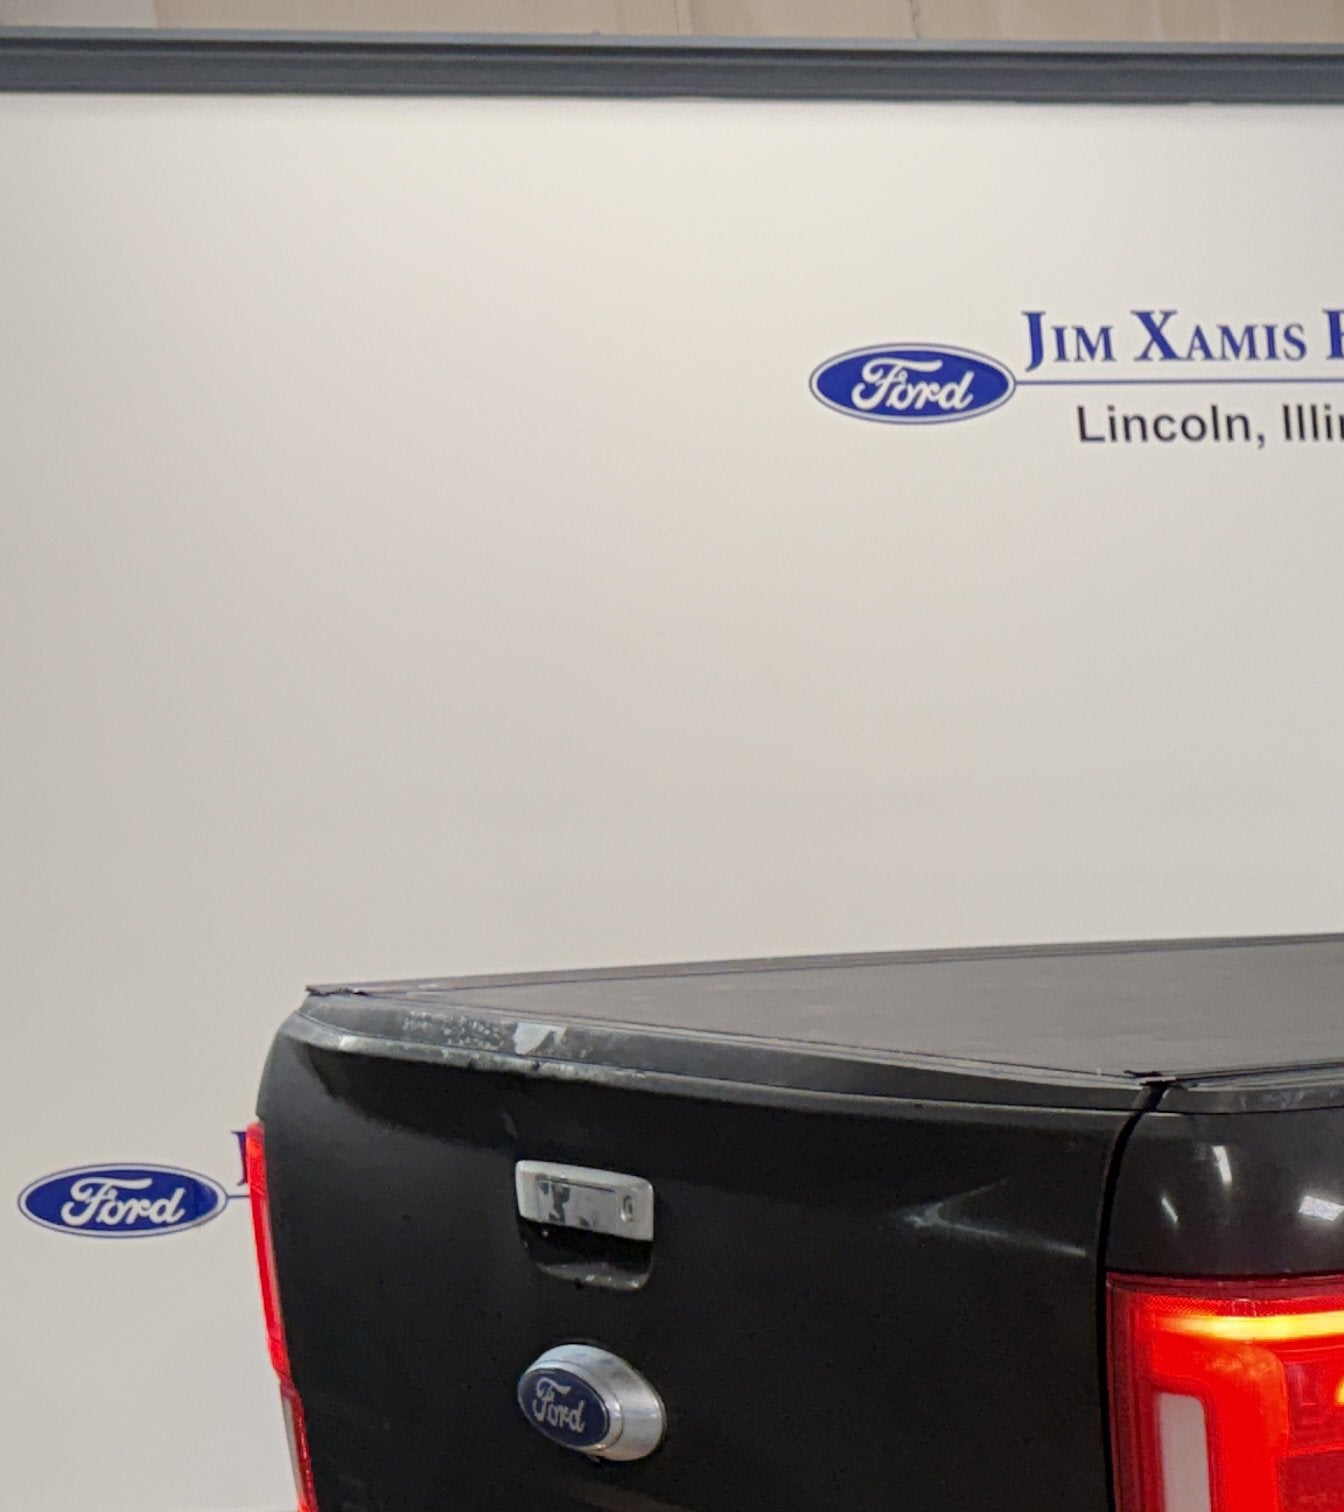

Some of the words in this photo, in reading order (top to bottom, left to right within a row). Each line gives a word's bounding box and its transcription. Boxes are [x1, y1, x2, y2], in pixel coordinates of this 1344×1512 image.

[1021, 310, 1117, 373] JIM
[1130, 309, 1308, 362] XAMIS
[851, 357, 976, 411] Ford
[1077, 403, 1266, 450] Lincoln,
[60, 1176, 186, 1226] Ford
[532, 1376, 587, 1434] Ford
